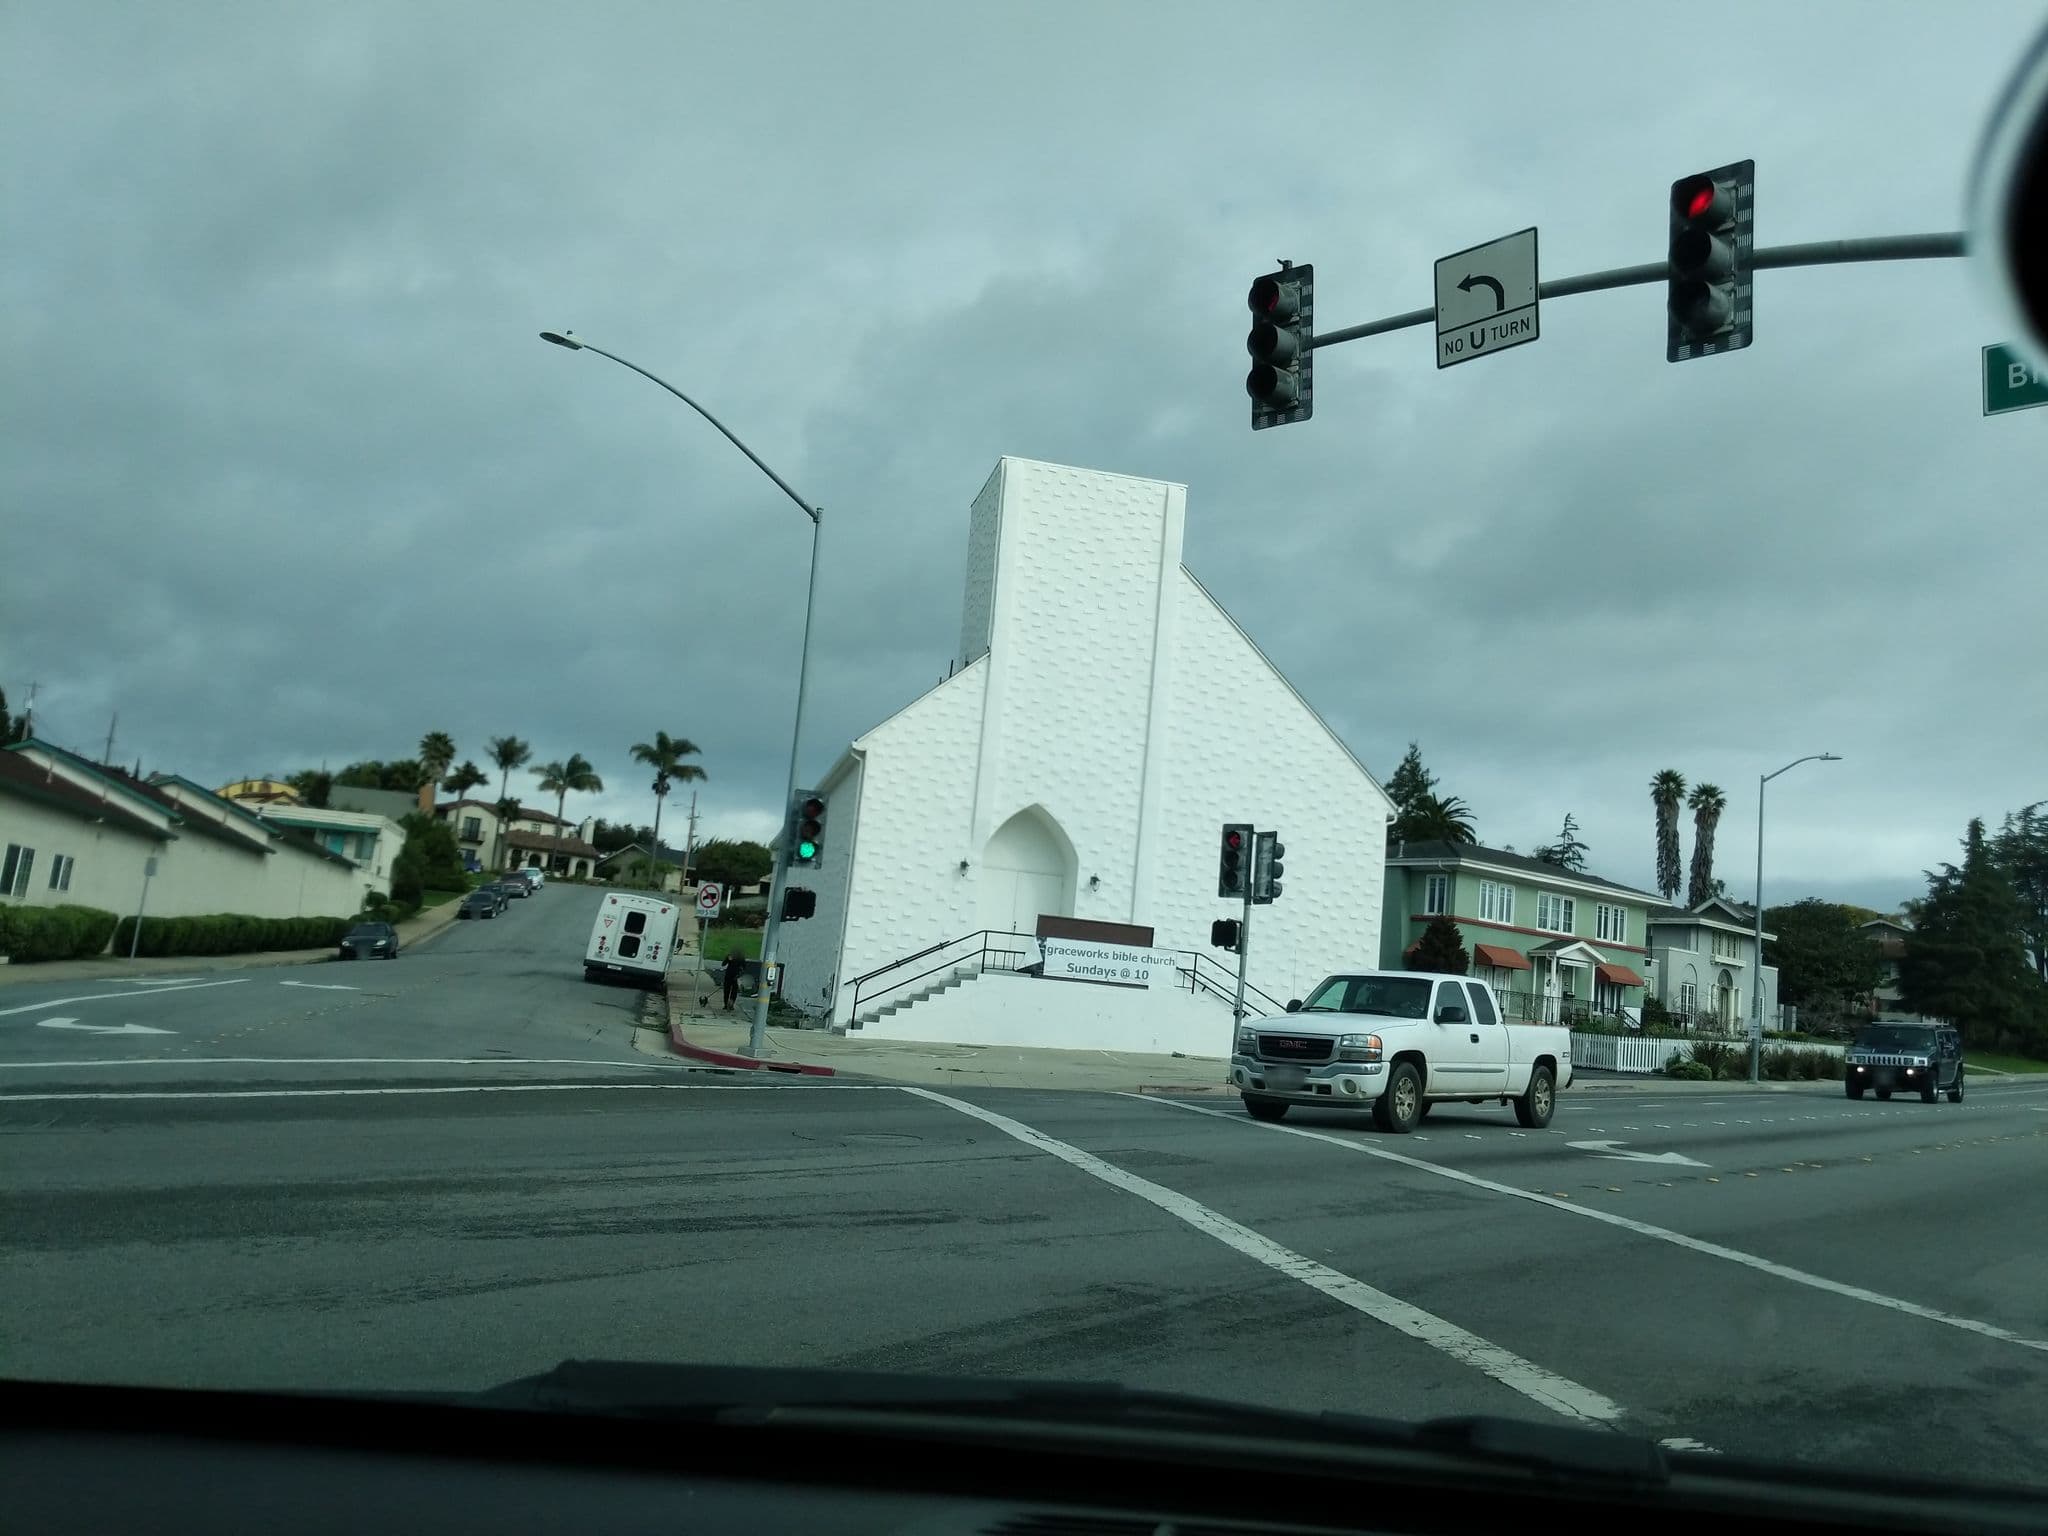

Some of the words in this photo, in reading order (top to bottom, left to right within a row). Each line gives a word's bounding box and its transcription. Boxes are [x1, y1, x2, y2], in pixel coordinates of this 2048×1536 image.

[1445, 338, 1463, 356] NO
[1469, 327, 1486, 350] U
[1490, 317, 1530, 341] TURN
[1046, 946, 1109, 960] graceworks
[1112, 951, 1138, 963] bible
[1140, 955, 1175, 966] church
[1066, 962, 1117, 979] Sundays
[1120, 968, 1131, 979] @
[1134, 969, 1149, 980] 10
